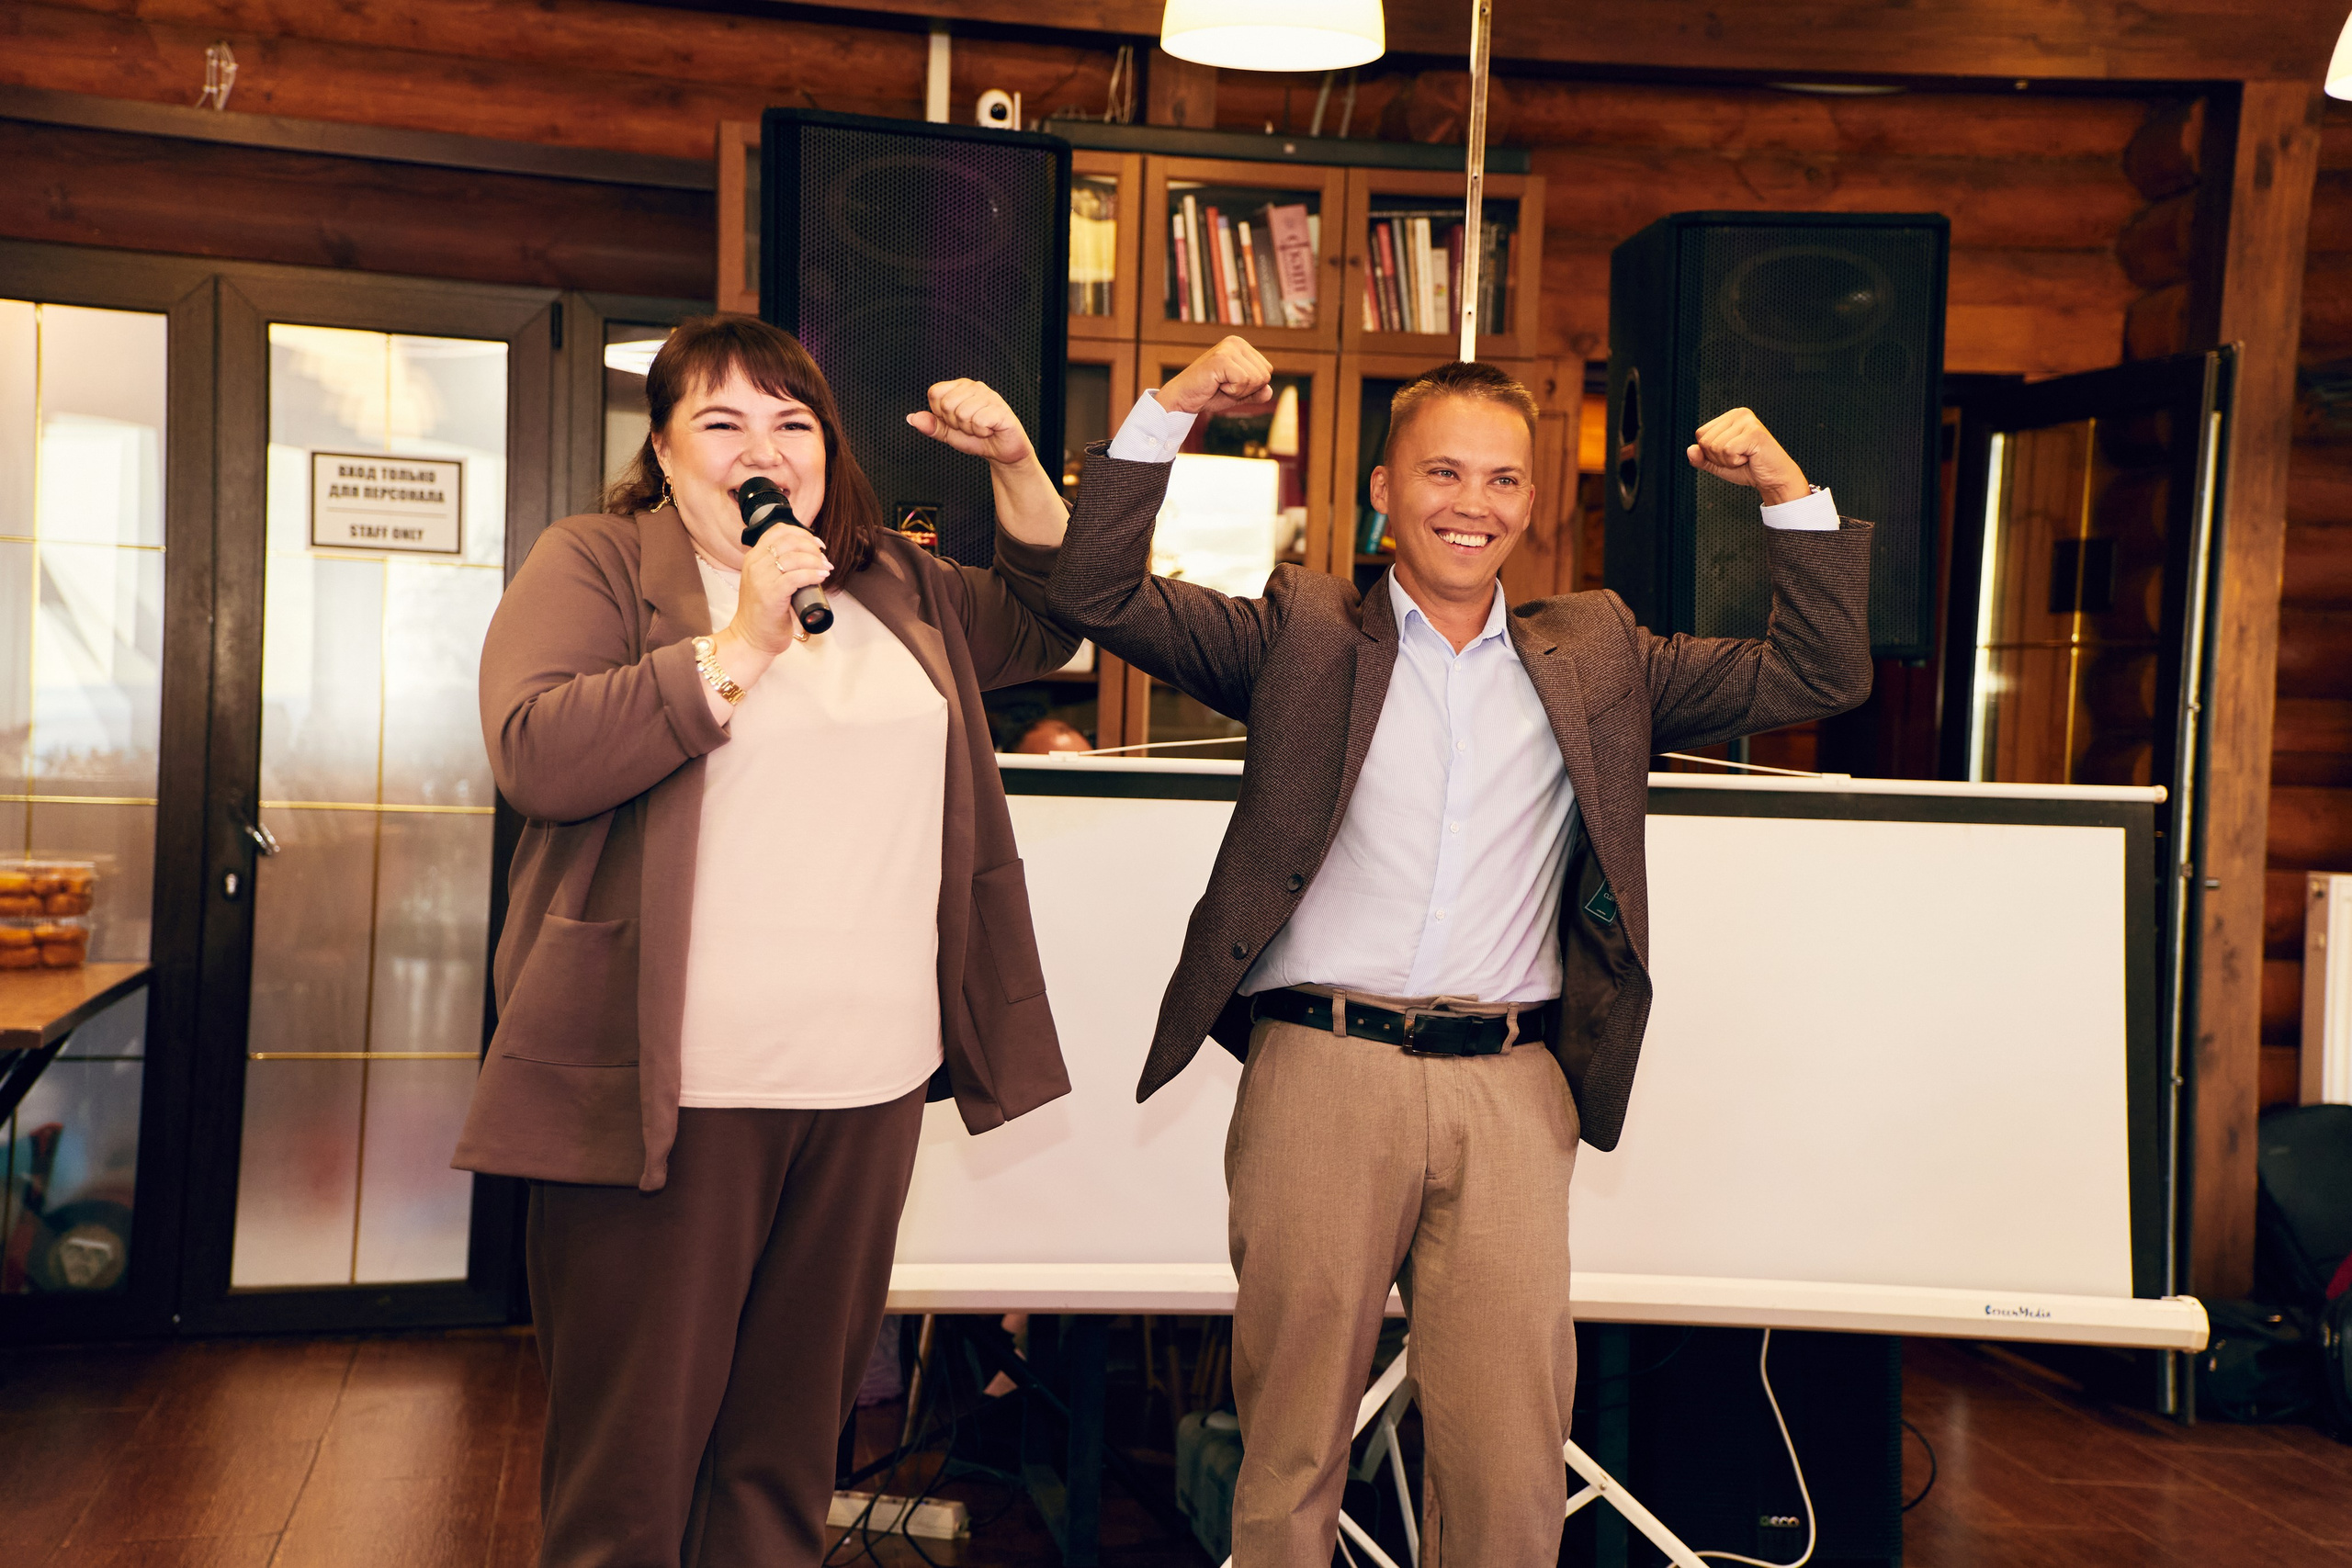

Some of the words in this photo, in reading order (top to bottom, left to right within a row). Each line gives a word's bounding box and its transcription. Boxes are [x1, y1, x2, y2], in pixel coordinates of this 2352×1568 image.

[338, 465, 377, 480] ВХОД
[381, 468, 436, 483] ТОЛЬКО
[329, 484, 359, 499] ДЛЯ
[364, 487, 446, 502] ПЕРСОНАЛА
[350, 524, 389, 538] STAFF
[392, 527, 424, 541] ONLY
